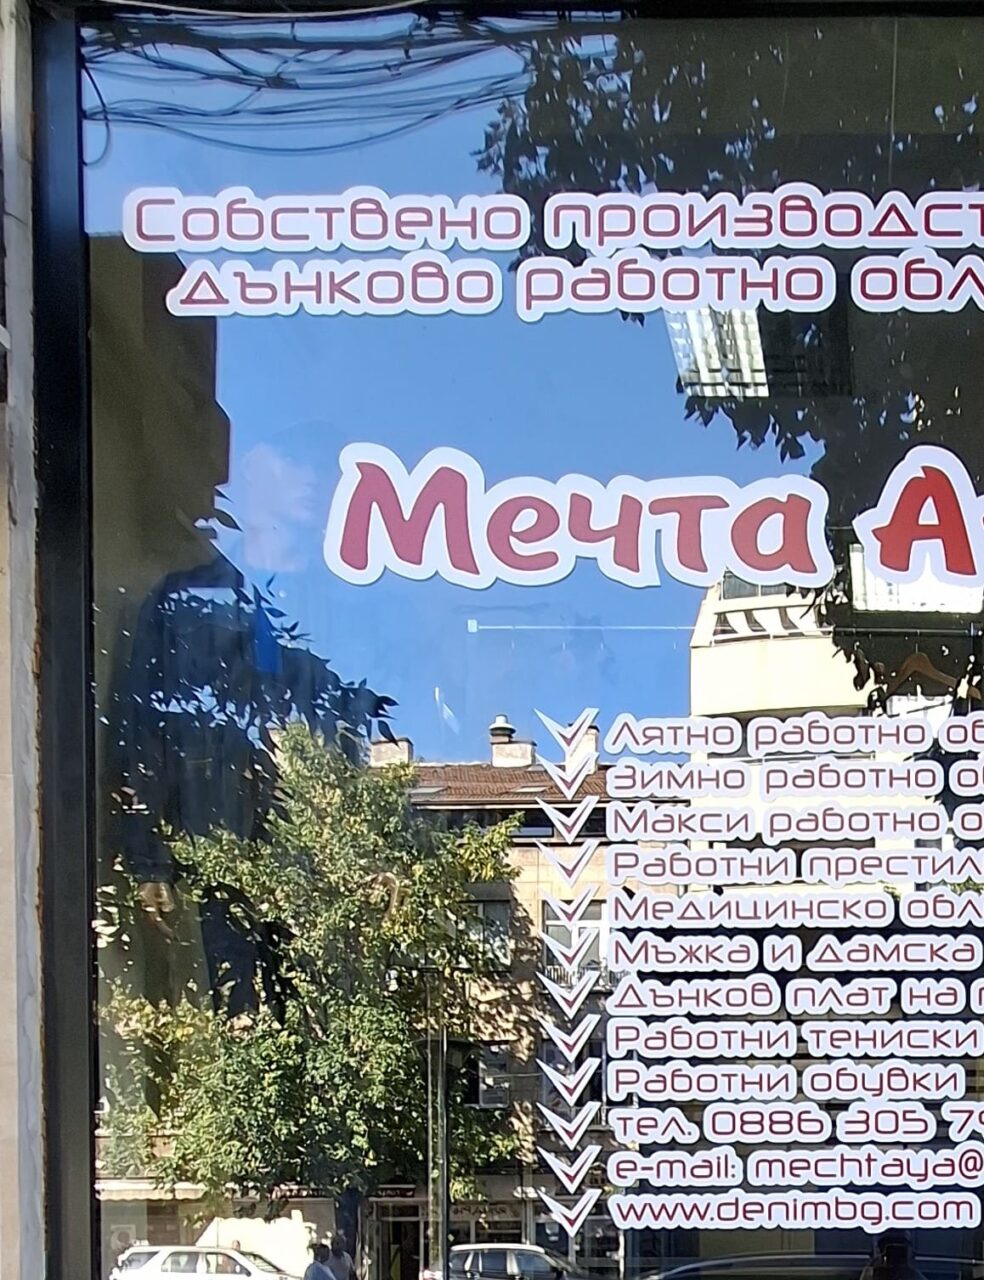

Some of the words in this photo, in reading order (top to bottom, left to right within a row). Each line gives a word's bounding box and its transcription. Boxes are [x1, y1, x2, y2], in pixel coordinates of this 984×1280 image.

[136, 197, 521, 242] Собствено
[527, 258, 823, 311] работно
[339, 461, 817, 576] Мечта
[612, 721, 735, 746] Лятно
[755, 719, 926, 750] работно
[614, 765, 745, 790] Зимно
[766, 763, 937, 794] работно
[613, 809, 749, 833] Макси
[769, 807, 940, 838] работно
[613, 852, 789, 877] Работни
[614, 896, 887, 921] Медицинско
[614, 939, 750, 964] Мъжка
[771, 944, 794, 964] и
[814, 943, 975, 964] дамска
[614, 983, 773, 1008] Дънков
[793, 986, 889, 1008] плат
[909, 986, 958, 1007] на
[615, 1025, 790, 1050] Работни
[810, 1029, 977, 1049] тениски
[615, 1068, 790, 1093] Работни
[810, 1067, 958, 1097] обувки
[616, 1117, 693, 1137] тел.
[711, 1110, 824, 1136] 0886
[844, 1110, 928, 1135] 305
[616, 1154, 736, 1179] e-mail:
[616, 1197, 974, 1226] www.denimbg.com
